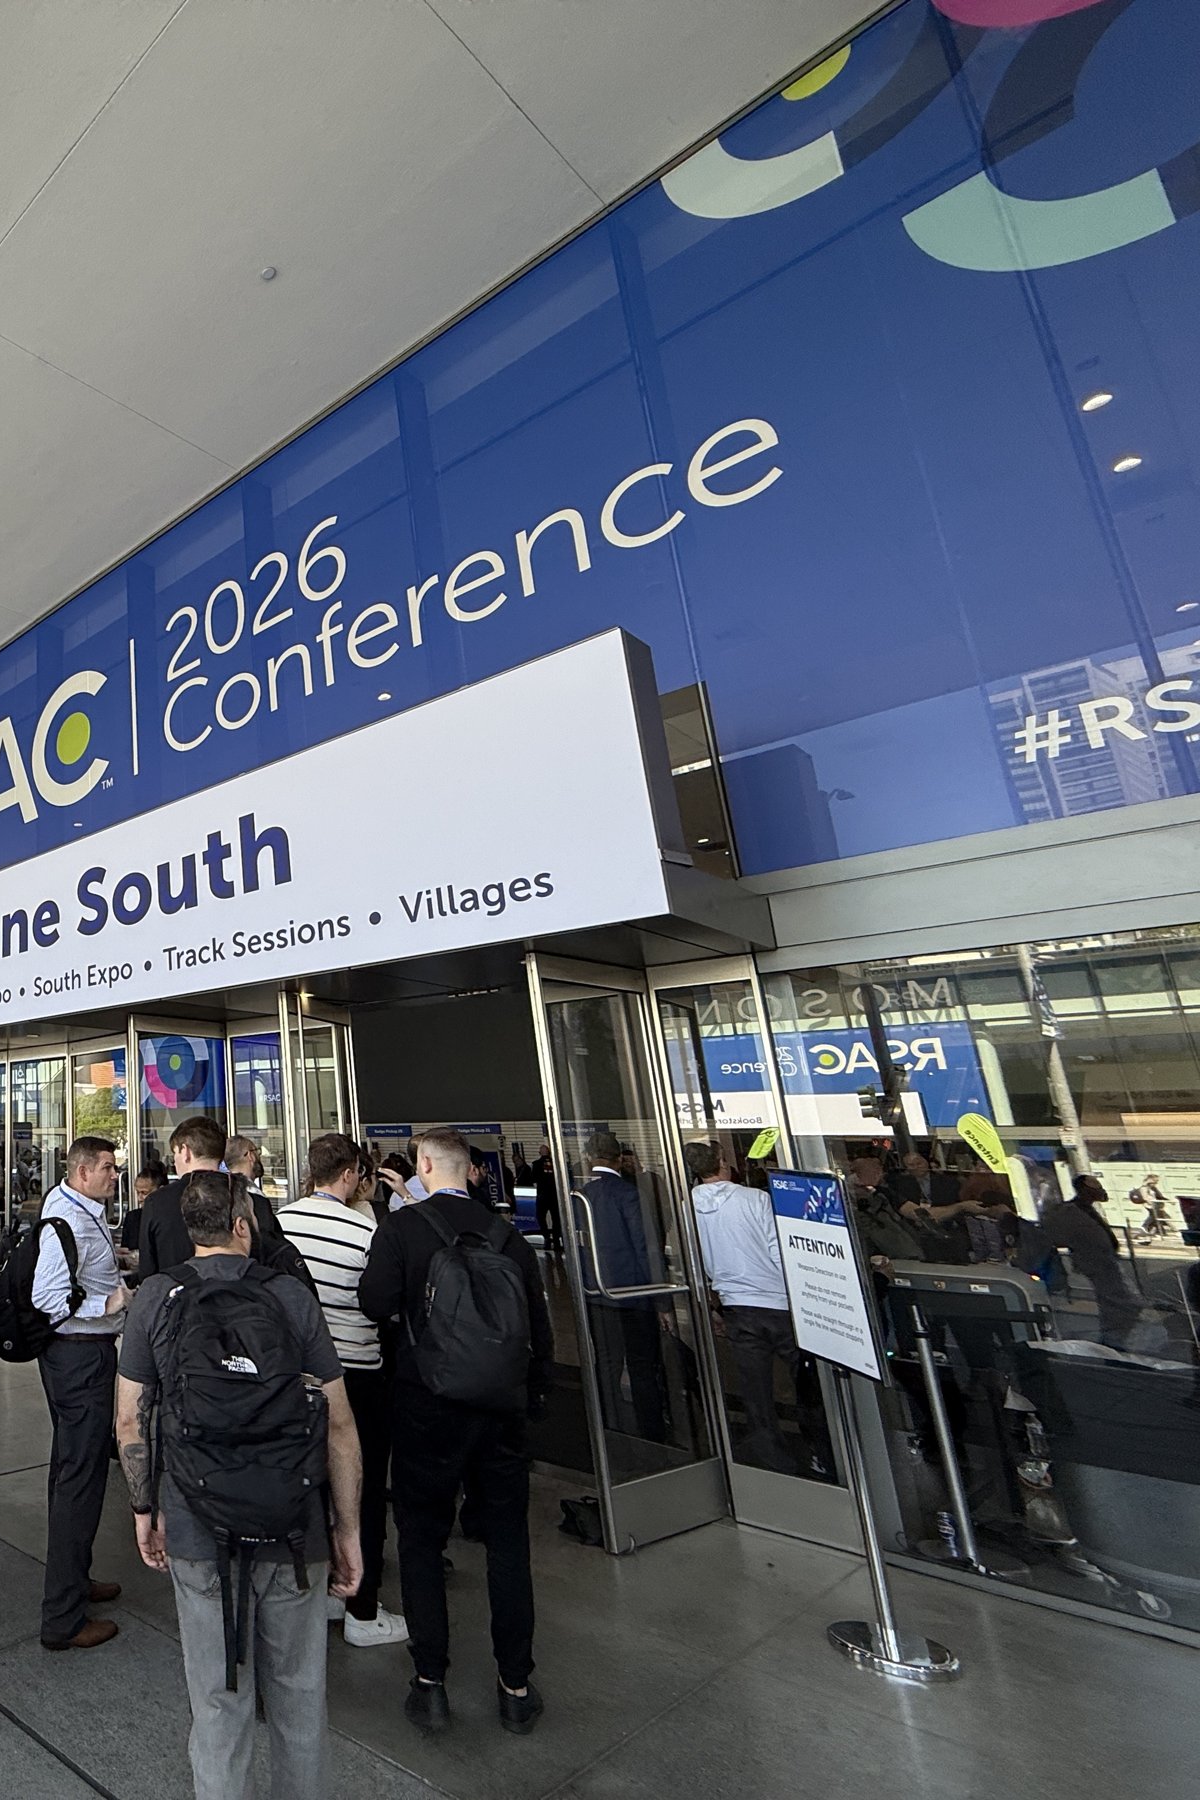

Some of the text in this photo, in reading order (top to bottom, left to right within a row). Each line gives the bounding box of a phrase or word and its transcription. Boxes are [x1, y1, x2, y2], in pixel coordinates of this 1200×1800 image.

[163, 418, 784, 751] Conference
[165, 515, 348, 682] 2026
[33, 969, 82, 997] South
[87, 961, 134, 990] Expo
[162, 938, 226, 973] Track
[232, 914, 351, 955] Sessions
[399, 870, 555, 923] Villages
[76, 813, 292, 936] South
[789, 1235, 846, 1260] ATTENTION
